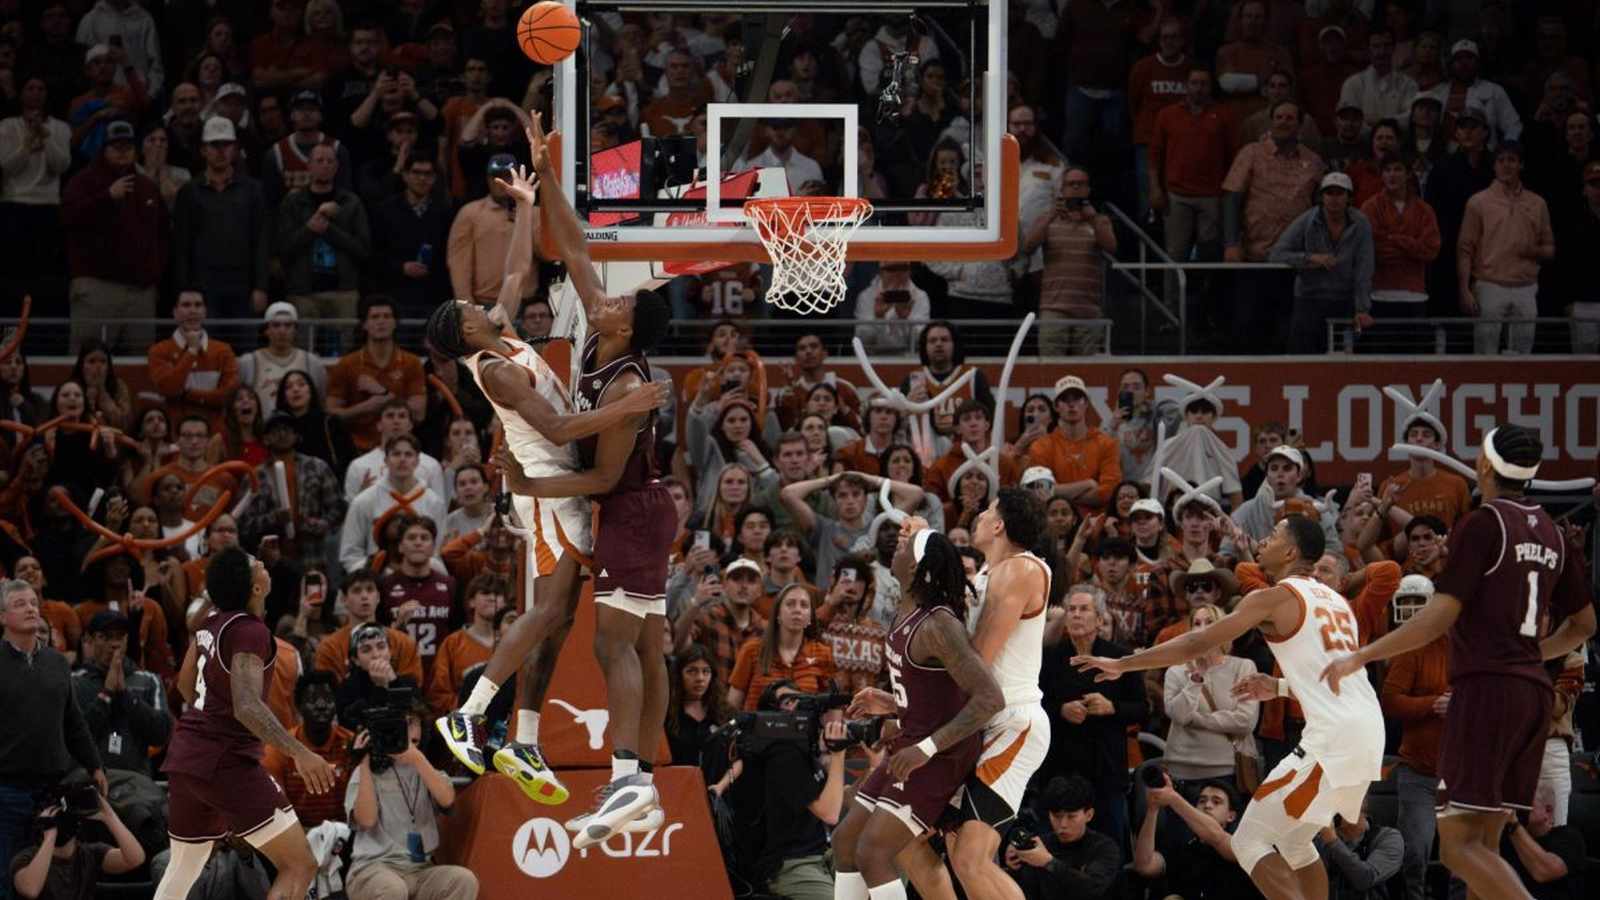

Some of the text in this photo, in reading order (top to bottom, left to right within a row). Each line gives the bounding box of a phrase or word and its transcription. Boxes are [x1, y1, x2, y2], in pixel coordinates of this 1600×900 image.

[1151, 80, 1187, 95] TEXA
[583, 231, 618, 241] ALDING
[711, 281, 744, 314] 16
[1514, 542, 1558, 569] PHELPS
[389, 607, 426, 619] TAS
[1519, 571, 1540, 638] 1
[405, 622, 437, 656] 12
[1312, 607, 1359, 653] 25
[579, 823, 684, 858] azr
